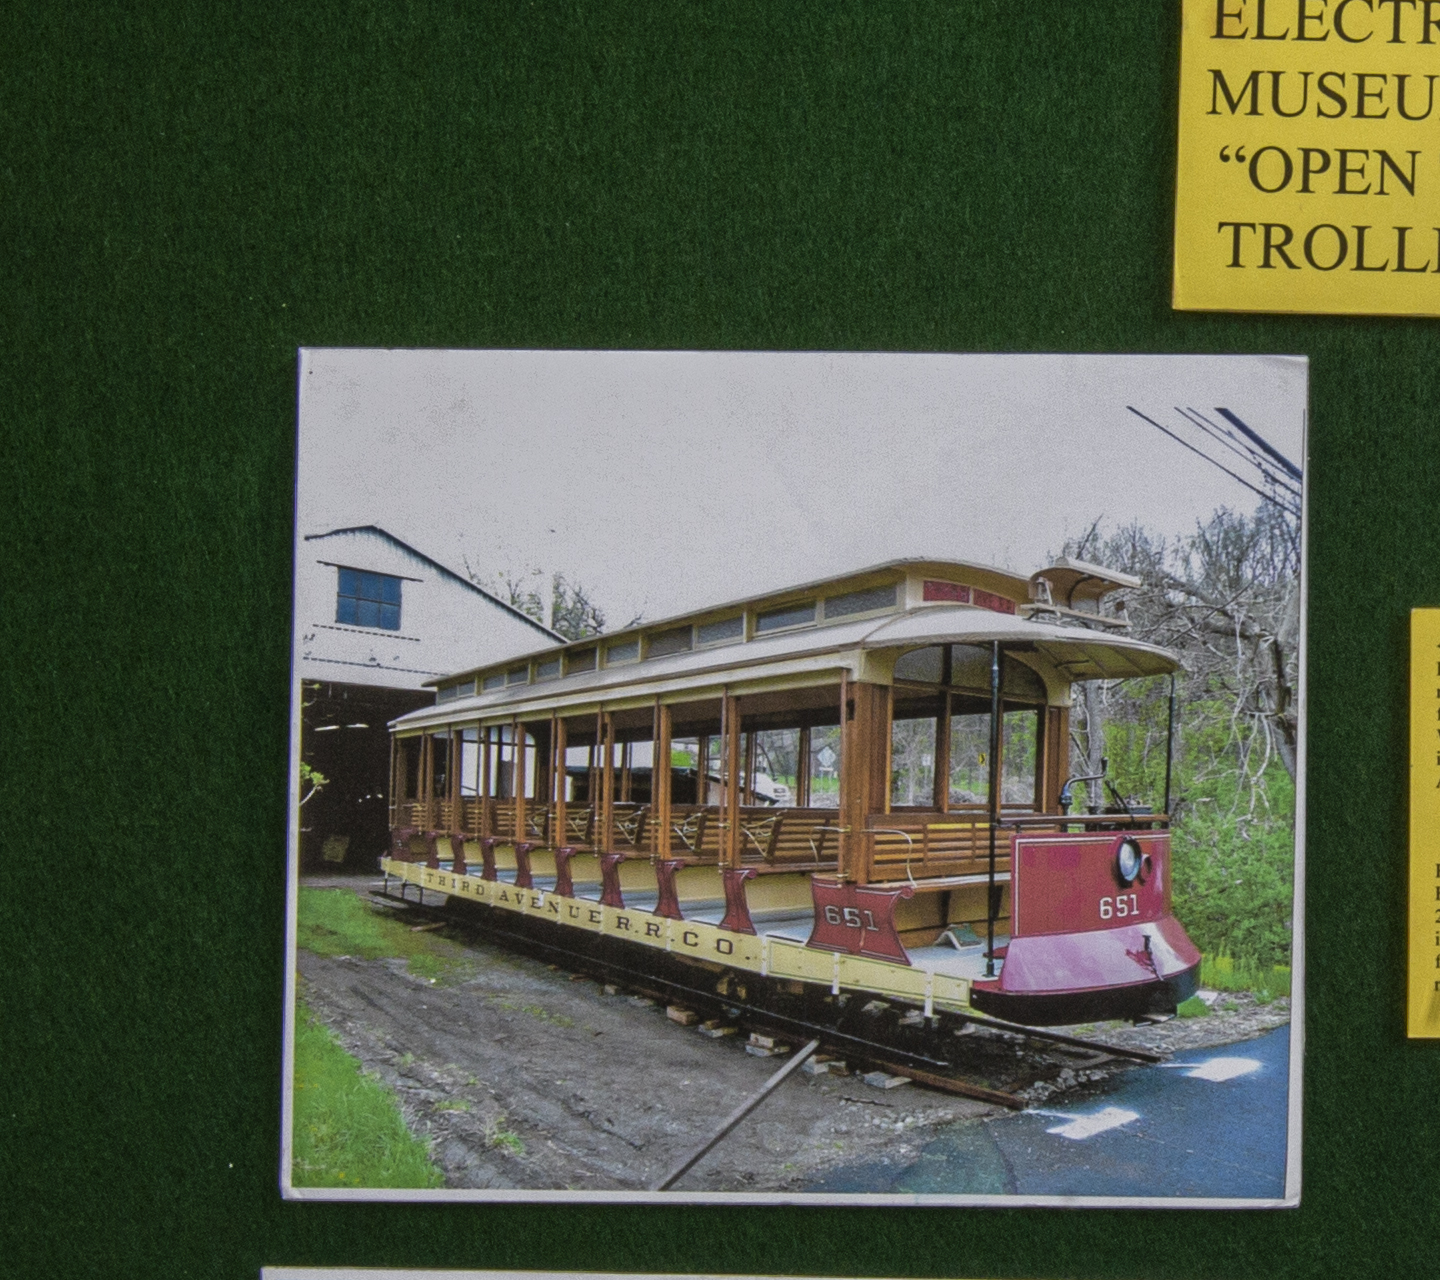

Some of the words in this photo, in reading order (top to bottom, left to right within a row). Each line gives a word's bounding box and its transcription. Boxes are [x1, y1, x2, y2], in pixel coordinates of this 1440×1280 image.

[1219, 145, 1421, 196] “OPEN
[426, 873, 486, 897] THIRD
[498, 889, 602, 924] AVENUE
[1099, 893, 1140, 919] 651
[824, 905, 880, 932] 651
